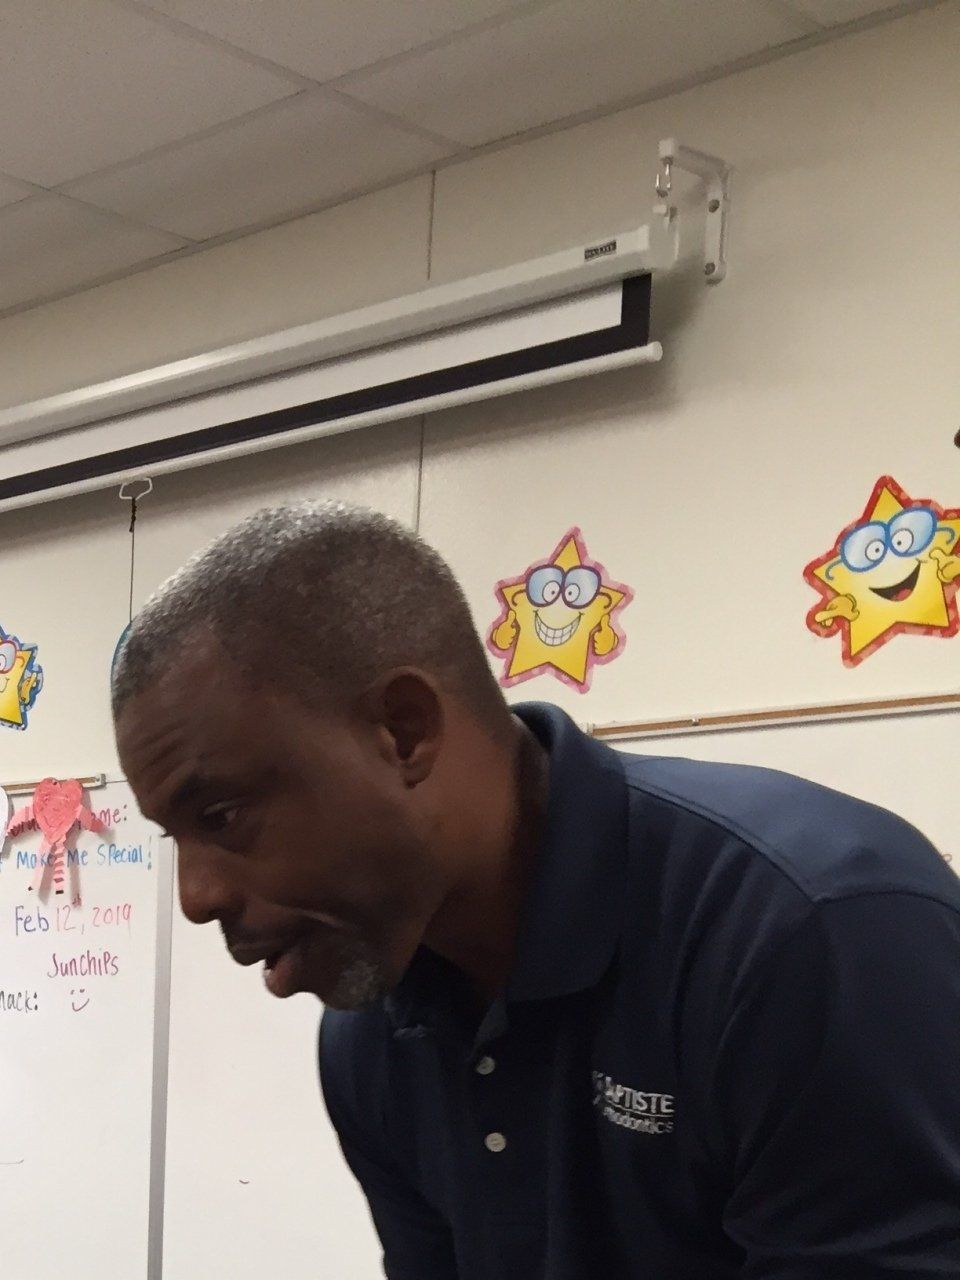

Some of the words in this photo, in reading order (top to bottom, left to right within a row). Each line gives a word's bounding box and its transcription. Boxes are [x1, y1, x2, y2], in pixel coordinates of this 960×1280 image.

[67, 848, 88, 865] Me
[14, 905, 50, 936] Feb
[56, 904, 85, 935] 12,
[92, 903, 133, 941] 2019
